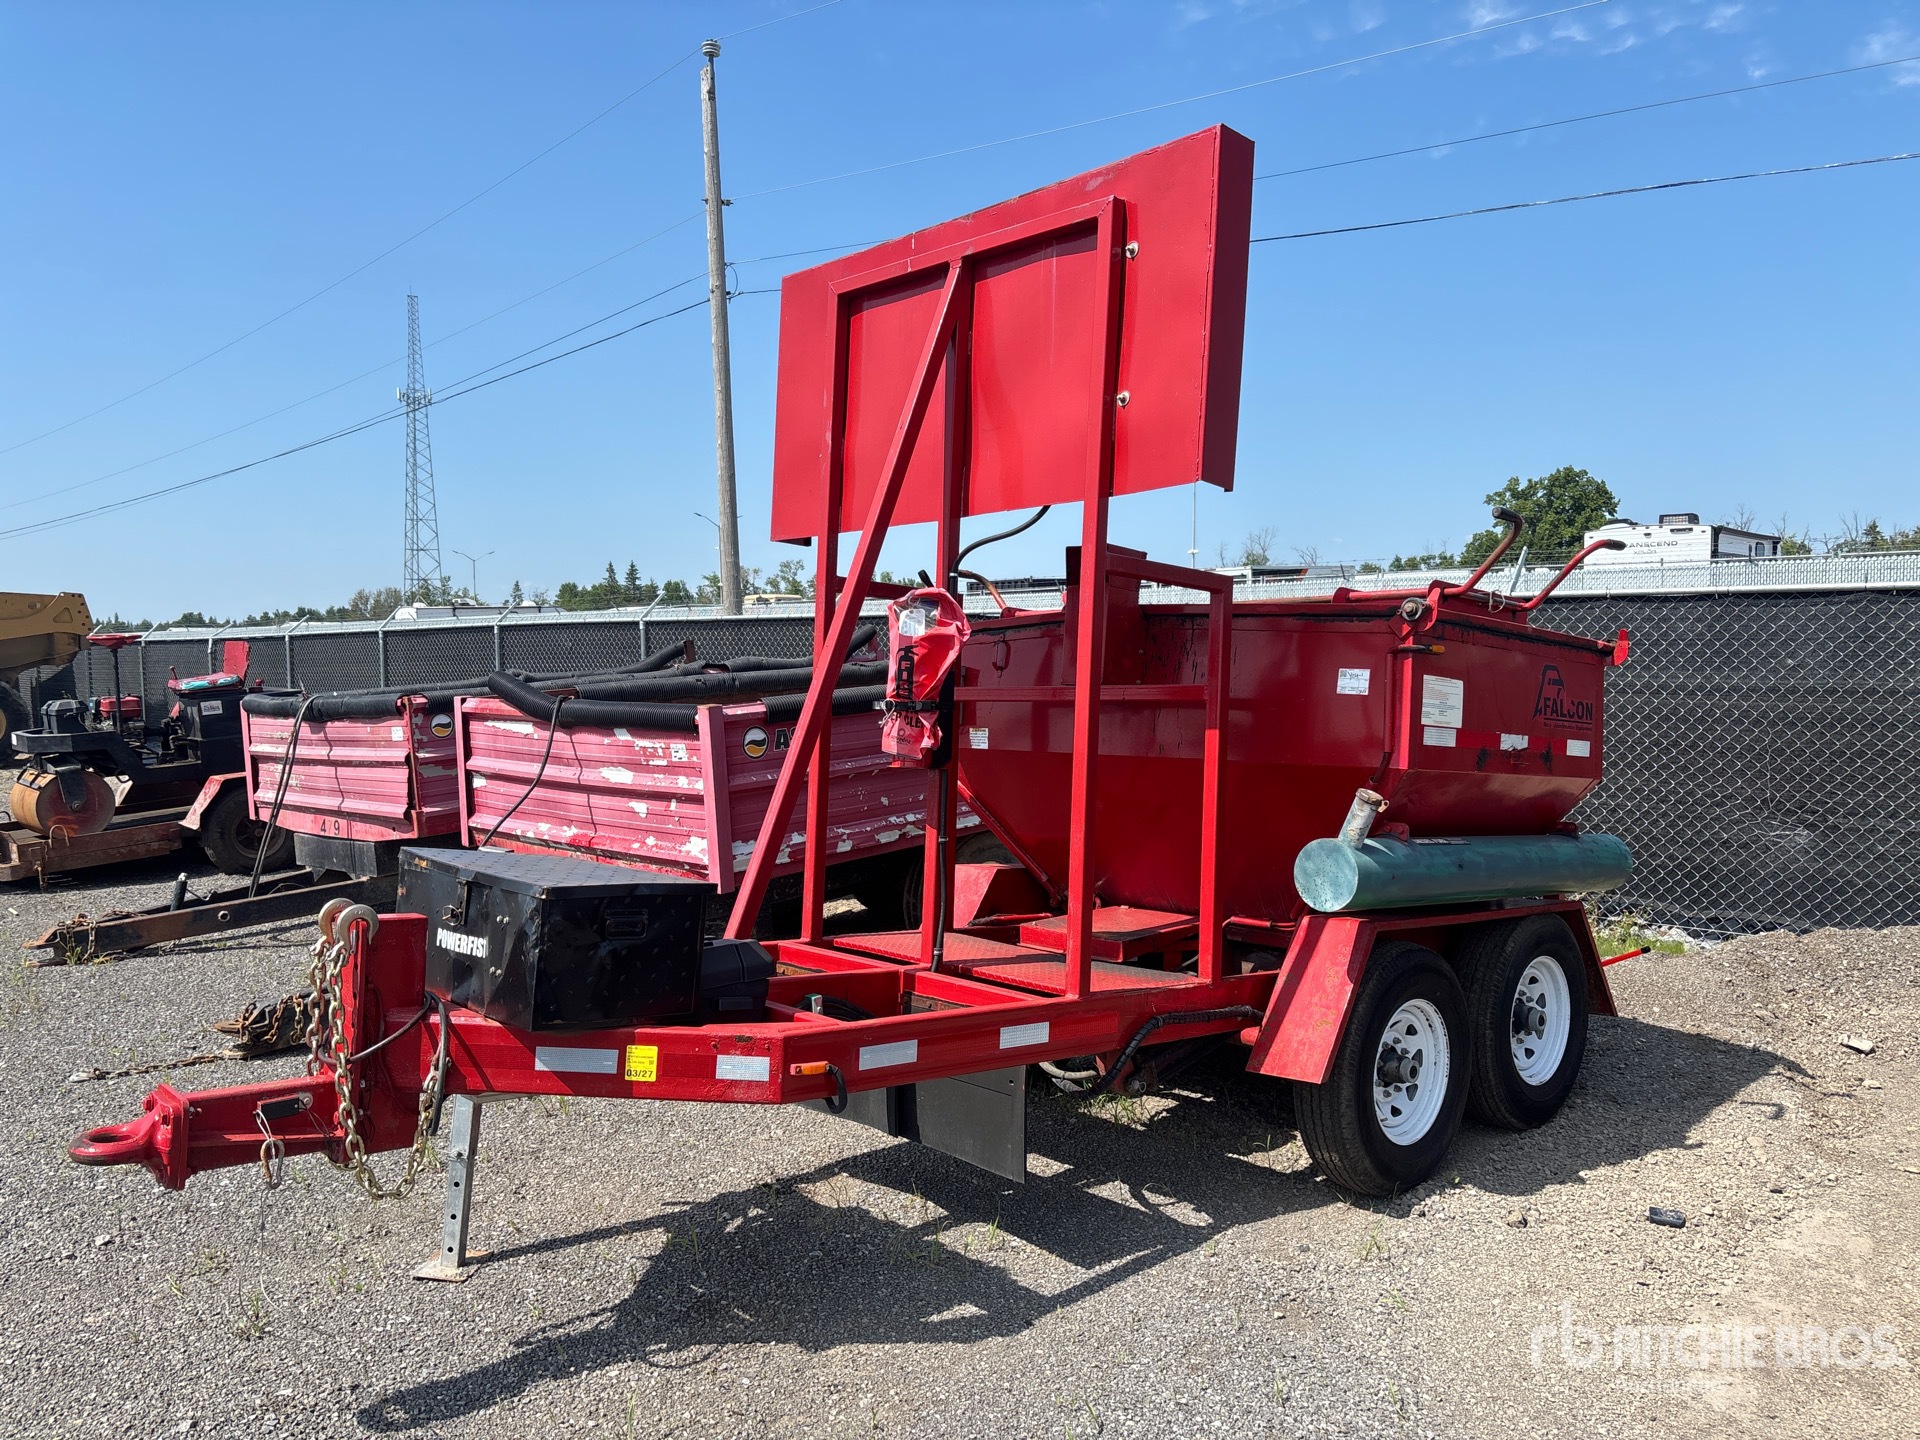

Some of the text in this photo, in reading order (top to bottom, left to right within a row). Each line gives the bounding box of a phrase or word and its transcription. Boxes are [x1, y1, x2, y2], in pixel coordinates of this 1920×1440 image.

[1625, 540, 1678, 548] ANSCEND
[1543, 696, 1593, 721] FALCON
[626, 1068, 653, 1078] 03/27
